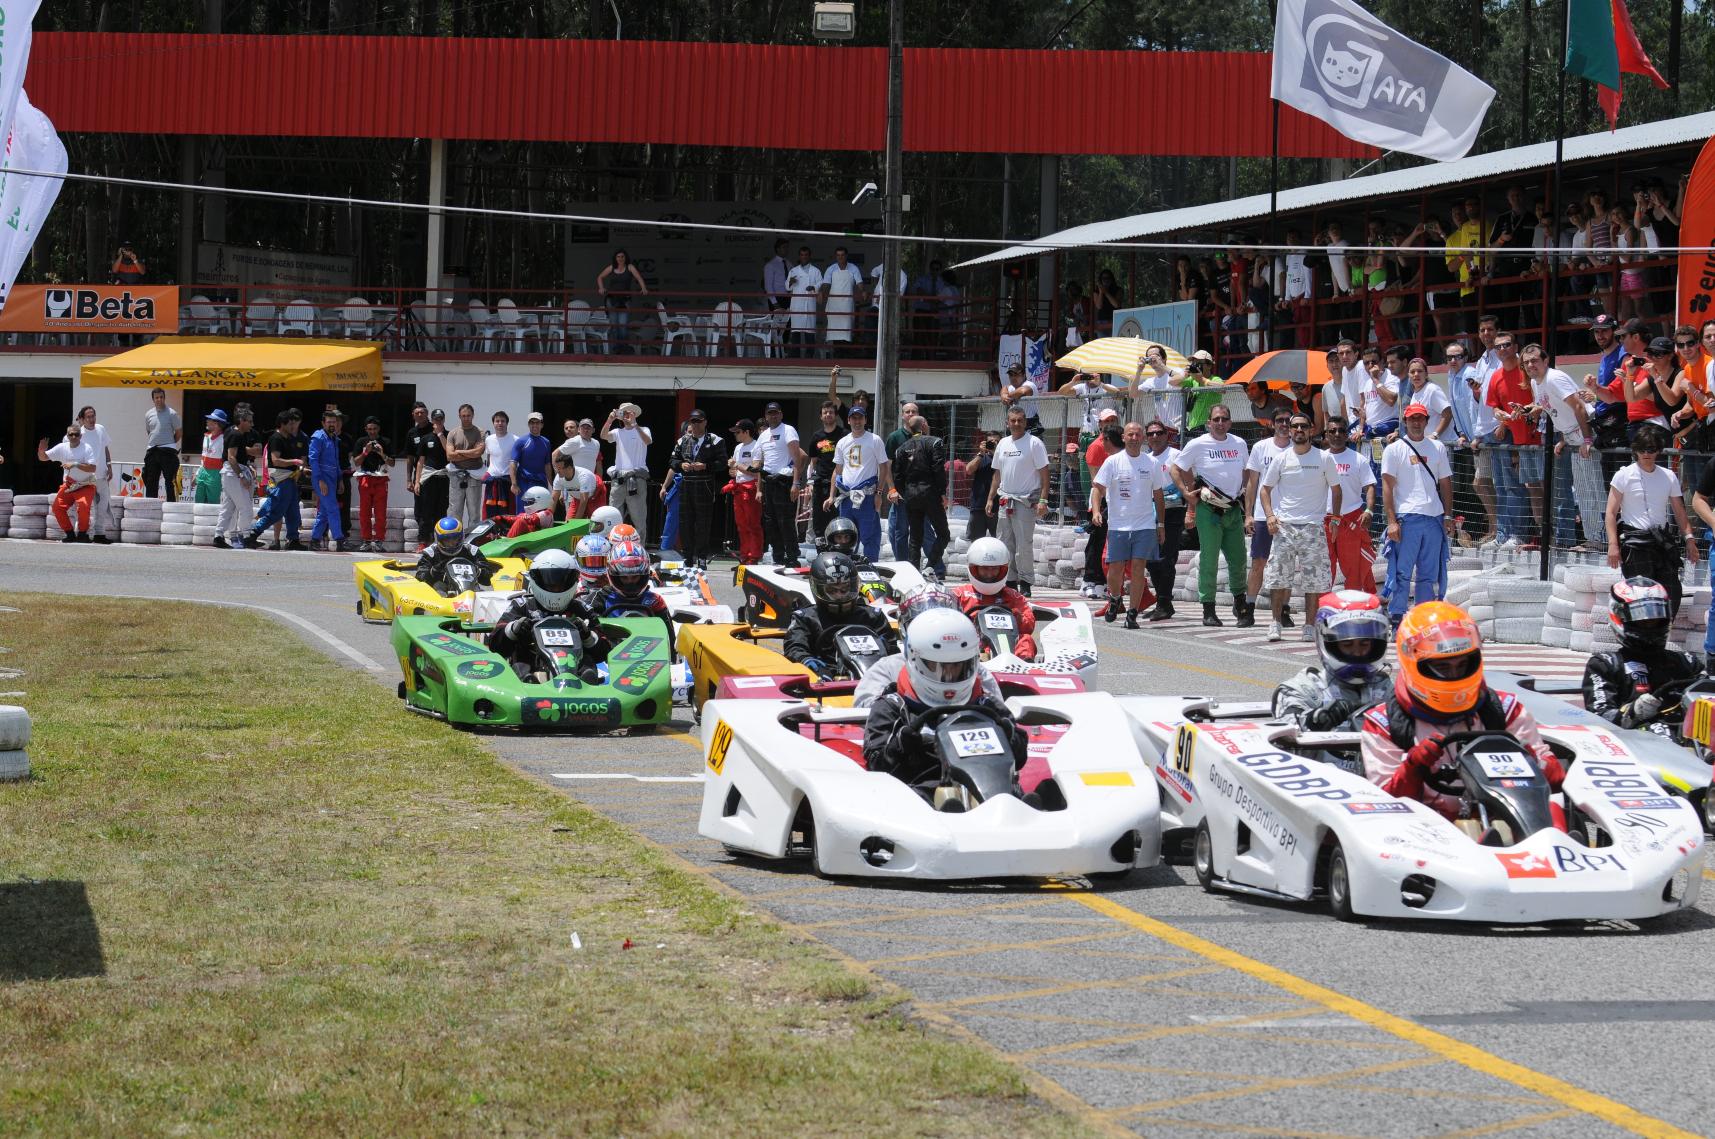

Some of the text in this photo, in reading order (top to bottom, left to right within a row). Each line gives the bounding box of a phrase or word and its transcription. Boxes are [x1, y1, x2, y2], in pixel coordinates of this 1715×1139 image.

[76, 289, 155, 320] Beta
[120, 378, 288, 390] www.pestronix.pt
[1208, 449, 1239, 460] UNITRIP
[851, 636, 869, 644] 67
[564, 702, 608, 715] JOGOS
[959, 730, 989, 742] 129
[708, 721, 733, 767] 129
[1177, 725, 1193, 773] 90
[1488, 754, 1512, 764] 90
[1209, 764, 1233, 798] Grupo
[1235, 786, 1280, 838] Desportivo
[1279, 829, 1297, 857] BPI
[1554, 846, 1626, 872] BPI
